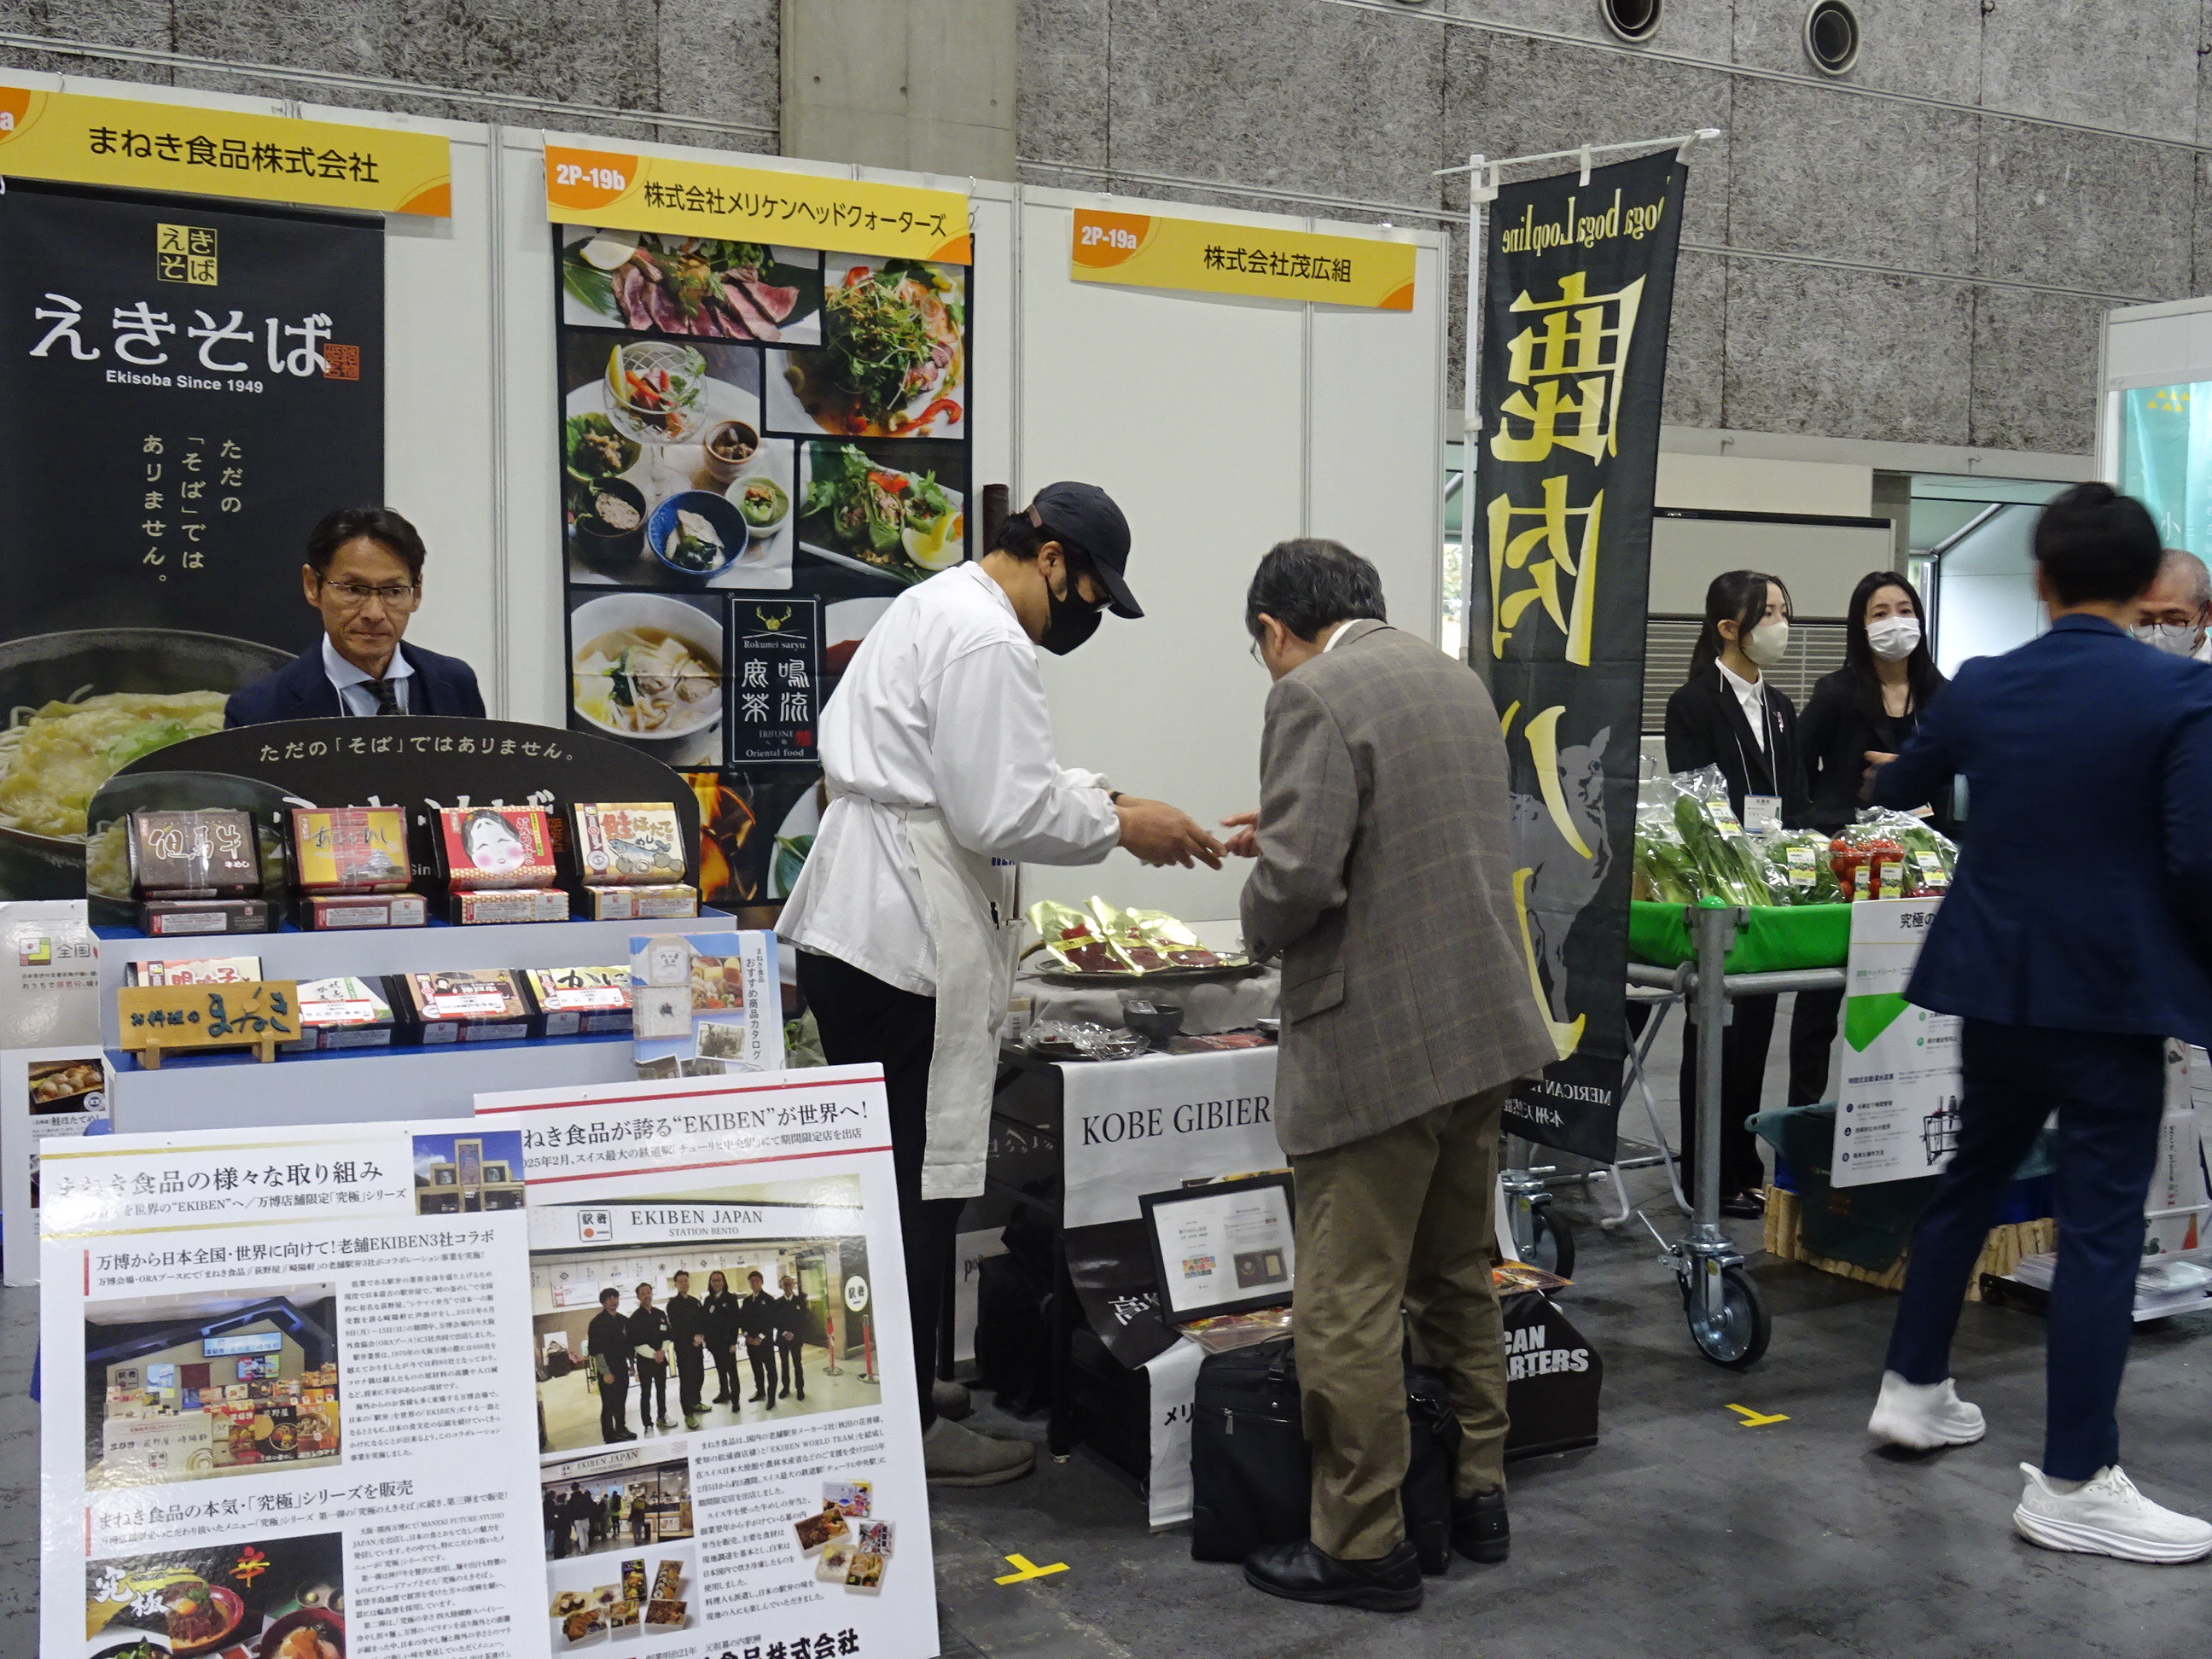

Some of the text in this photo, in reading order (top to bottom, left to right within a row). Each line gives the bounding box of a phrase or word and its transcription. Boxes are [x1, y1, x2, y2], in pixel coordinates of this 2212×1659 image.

[89, 126, 379, 183] まねき食品株式会社
[556, 163, 626, 192] 2P-19b
[643, 180, 947, 237] 株式会社メリケンヘッドクォーターズ
[1081, 225, 1138, 250] 2P-19a
[1203, 244, 1352, 283] 株式会社茂広組
[29, 293, 334, 376] えきそば
[105, 369, 264, 393] Ekisoba Since 1949
[220, 439, 243, 513] ただの
[142, 434, 167, 582] ありません。
[181, 437, 207, 569] 「そば」では
[744, 640, 806, 651] Rokumei saryu
[259, 736, 573, 762] ただの「そば」ではありません。
[746, 748, 805, 758] Oriental food
[746, 958, 761, 1060] おすすめ商品カタログ
[1082, 1108, 1163, 1145] KOBE
[1173, 1096, 1272, 1133] GIBIER
[631, 1210, 763, 1225] EKIBEN JAPAN
[669, 1226, 739, 1237] STATION BENTO
[1505, 1348, 1589, 1382] RTERS
[802, 1437, 830, 1449] WORLD
[577, 1457, 606, 1470] EKIBEN
